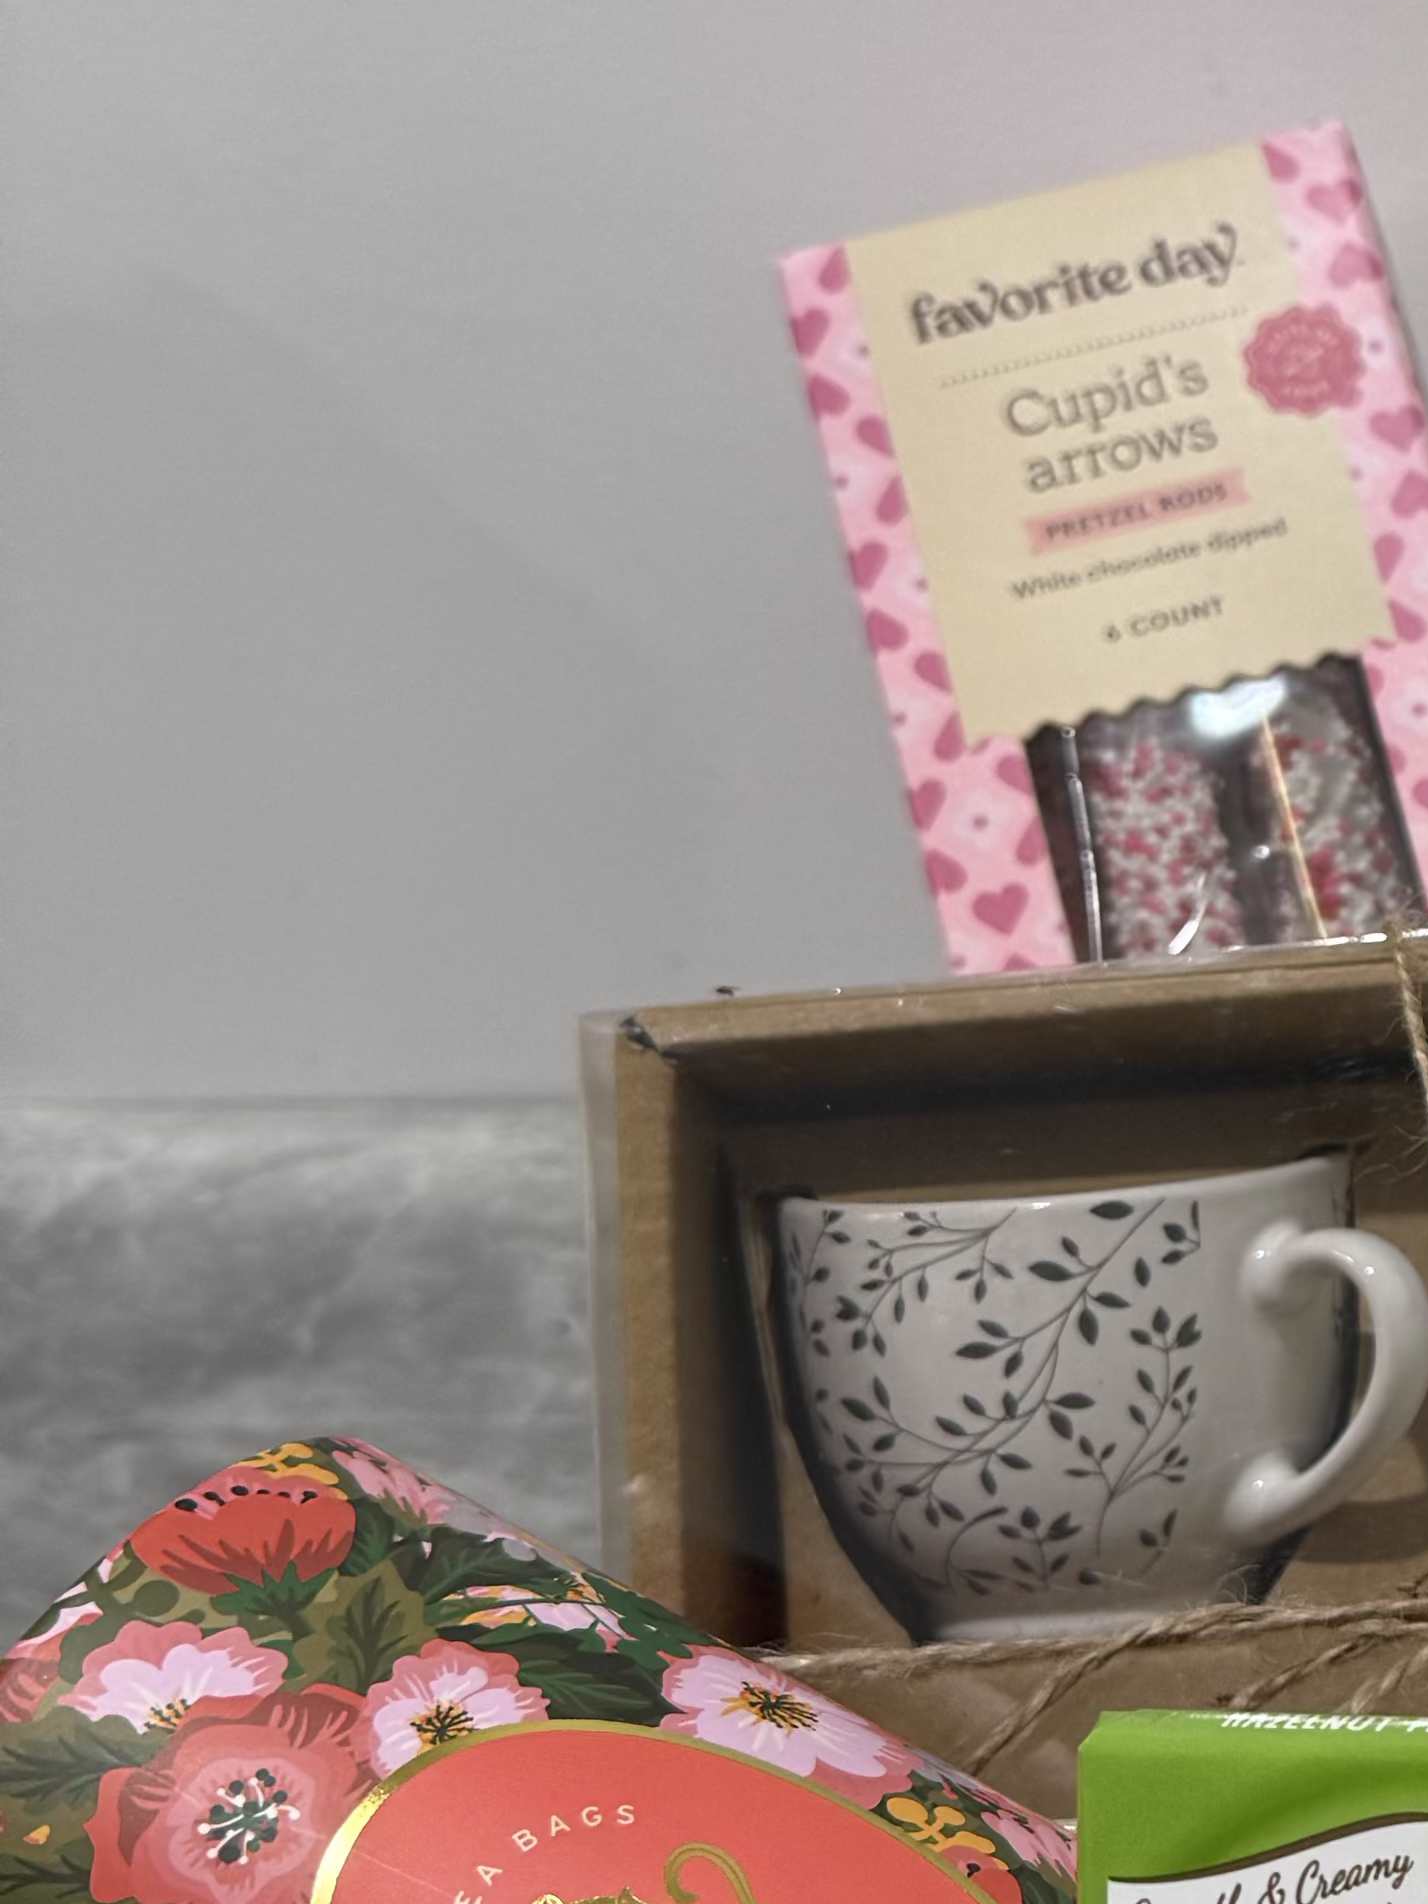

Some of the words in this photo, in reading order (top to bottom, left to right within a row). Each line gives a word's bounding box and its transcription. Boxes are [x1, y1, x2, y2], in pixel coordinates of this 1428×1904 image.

[907, 252, 1134, 348] favorite
[1138, 223, 1239, 290] day
[1003, 353, 1211, 440] Cupid's
[1024, 412, 1220, 494] arrows
[1045, 503, 1151, 542] PRETZEL
[1159, 481, 1229, 512] RODS
[1010, 572, 1082, 599] White
[1087, 542, 1201, 582] chocolate
[1206, 516, 1288, 551] dipped
[1129, 596, 1225, 637] COUNT
[513, 1802, 637, 1854] BAGS
